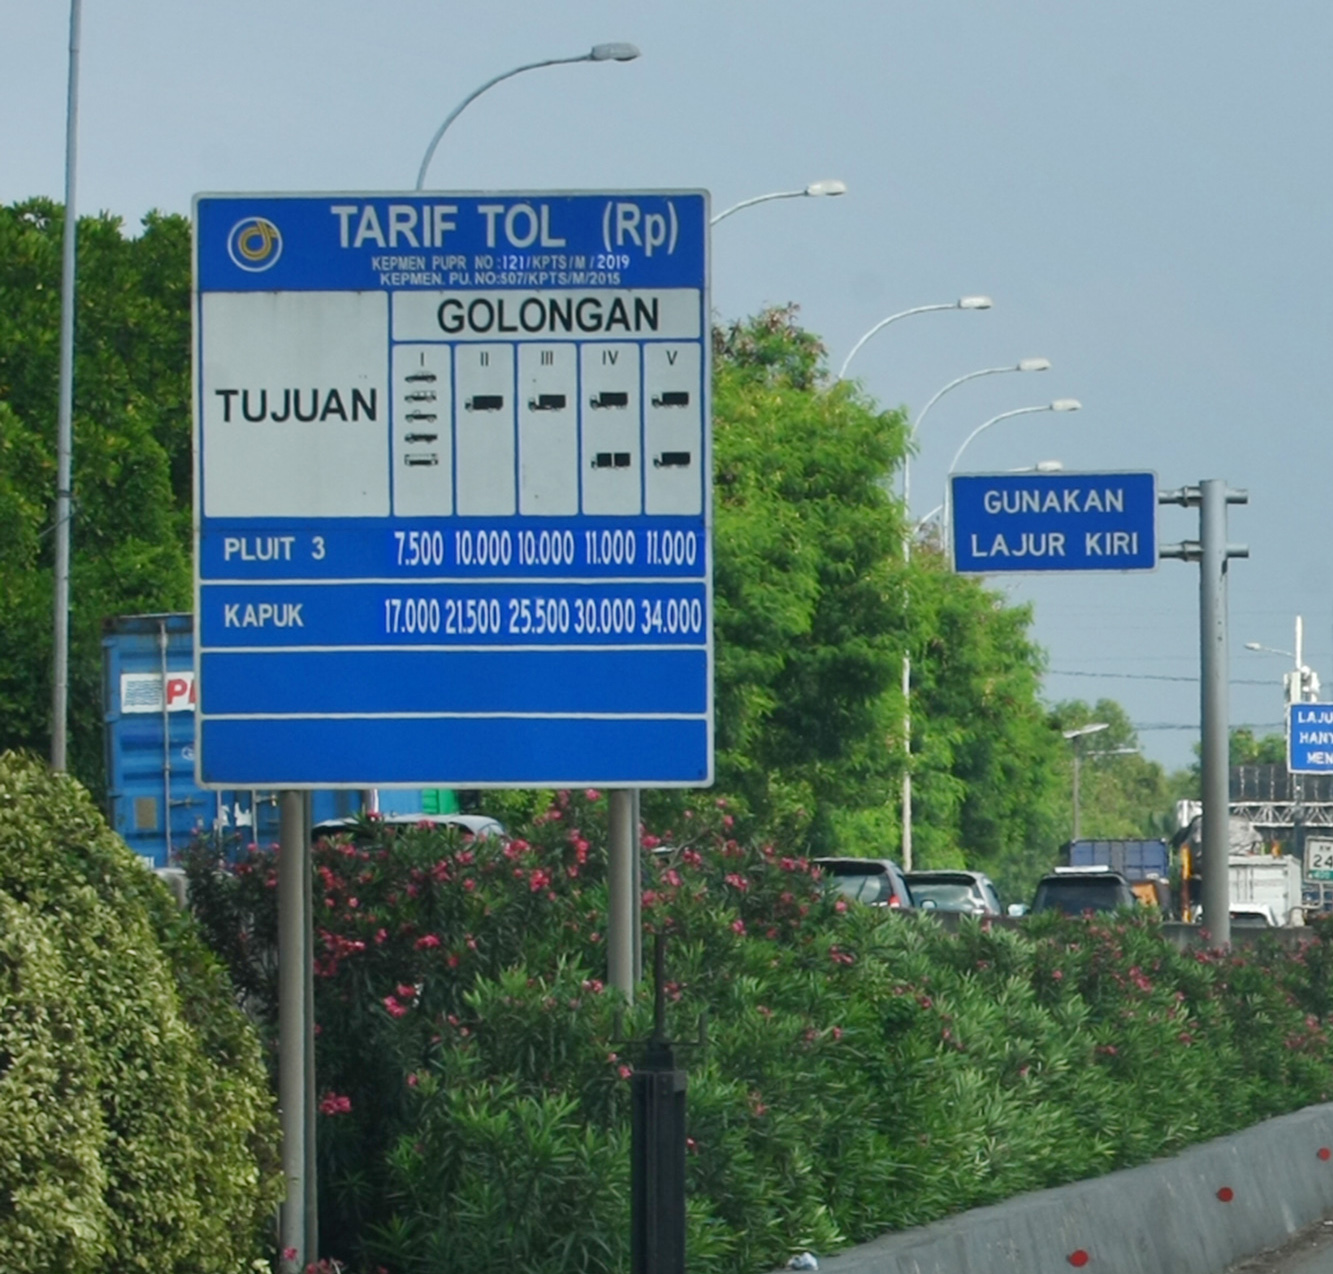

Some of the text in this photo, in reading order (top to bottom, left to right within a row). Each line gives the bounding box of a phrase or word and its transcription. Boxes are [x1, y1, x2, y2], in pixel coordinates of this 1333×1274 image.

[330, 201, 679, 256] TARIF TOL (Rp)
[371, 255, 426, 271] KEPMEN
[432, 255, 467, 271] PUPR
[437, 297, 660, 334] GOLONGAN
[419, 350, 678, 366] I II III IV V
[216, 387, 378, 423] TUJUAN
[983, 488, 1124, 514] GUNAKAN
[223, 530, 697, 567] PLUIT 3 7.500 10.000 10.000 11.000 11.000
[970, 532, 1139, 558] LAJUR KIRI
[223, 598, 702, 635] KAPUK 17.000 21.500 25.500 30.000 34.000
[1313, 854, 1333, 868] 24
